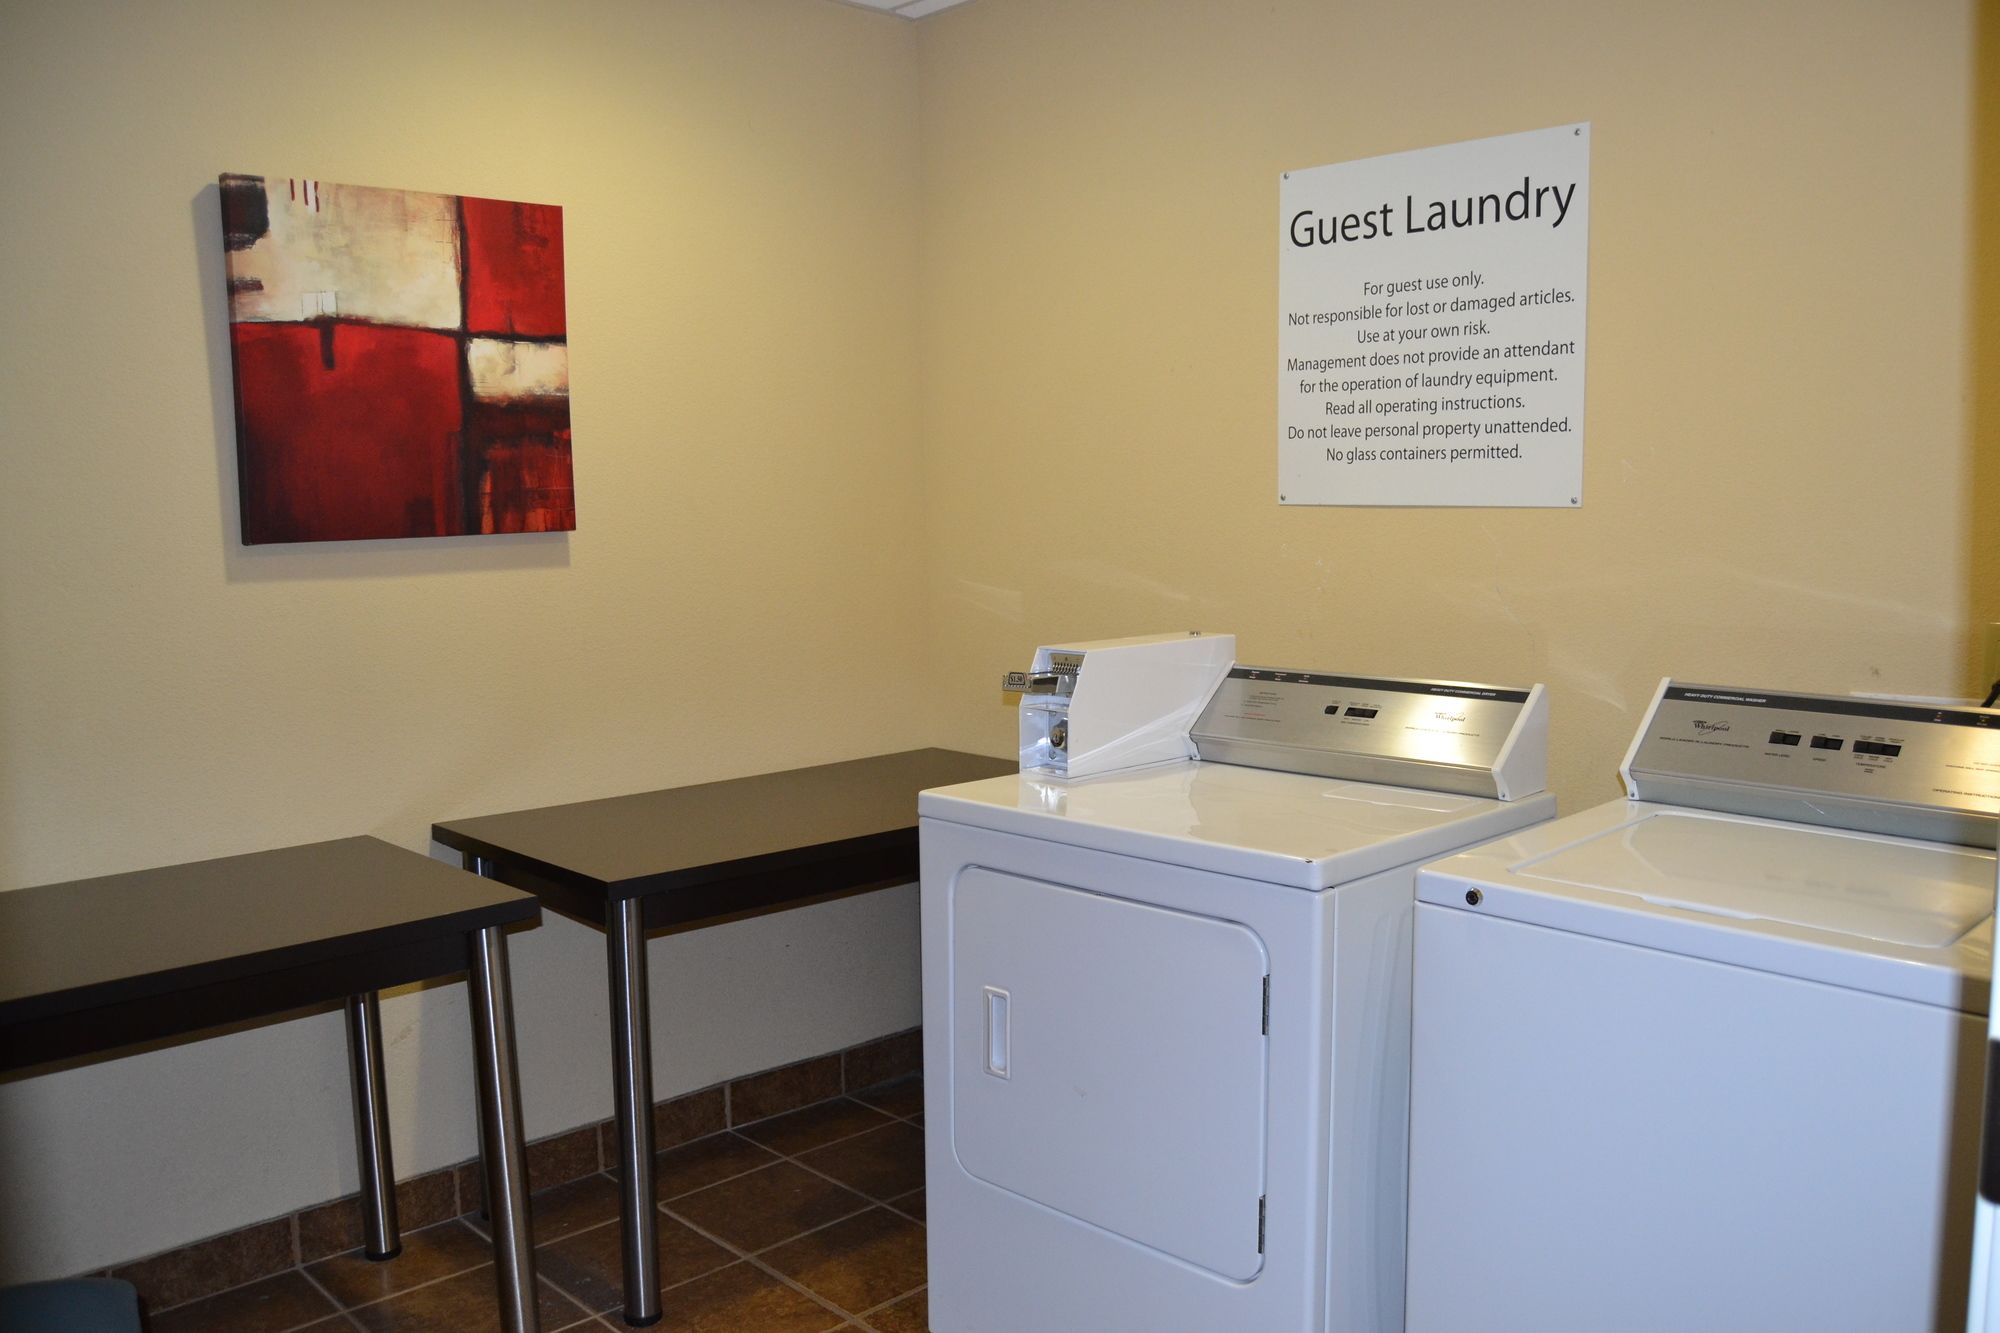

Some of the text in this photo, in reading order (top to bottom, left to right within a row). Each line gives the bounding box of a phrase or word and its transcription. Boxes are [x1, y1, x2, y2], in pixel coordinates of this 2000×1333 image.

[1290, 176, 1576, 248] Guest Laundry
[1364, 270, 1484, 298] For guest use only.
[1288, 288, 1575, 326] Not responsible for lost or damaged articles.
[1357, 319, 1490, 345] Use at your own risk.
[1287, 340, 1575, 374] Management does not provide an attendant
[1299, 368, 1558, 395] for the operation of laundry equipment.
[1325, 394, 1525, 417] Read all operating instructions.
[1288, 416, 1572, 441] Do not leave personal property unattended.
[1326, 443, 1522, 465] No glass containers permitted.
[1435, 714, 1466, 722] Whirlpool
[1694, 722, 1730, 732] Whirlpool
